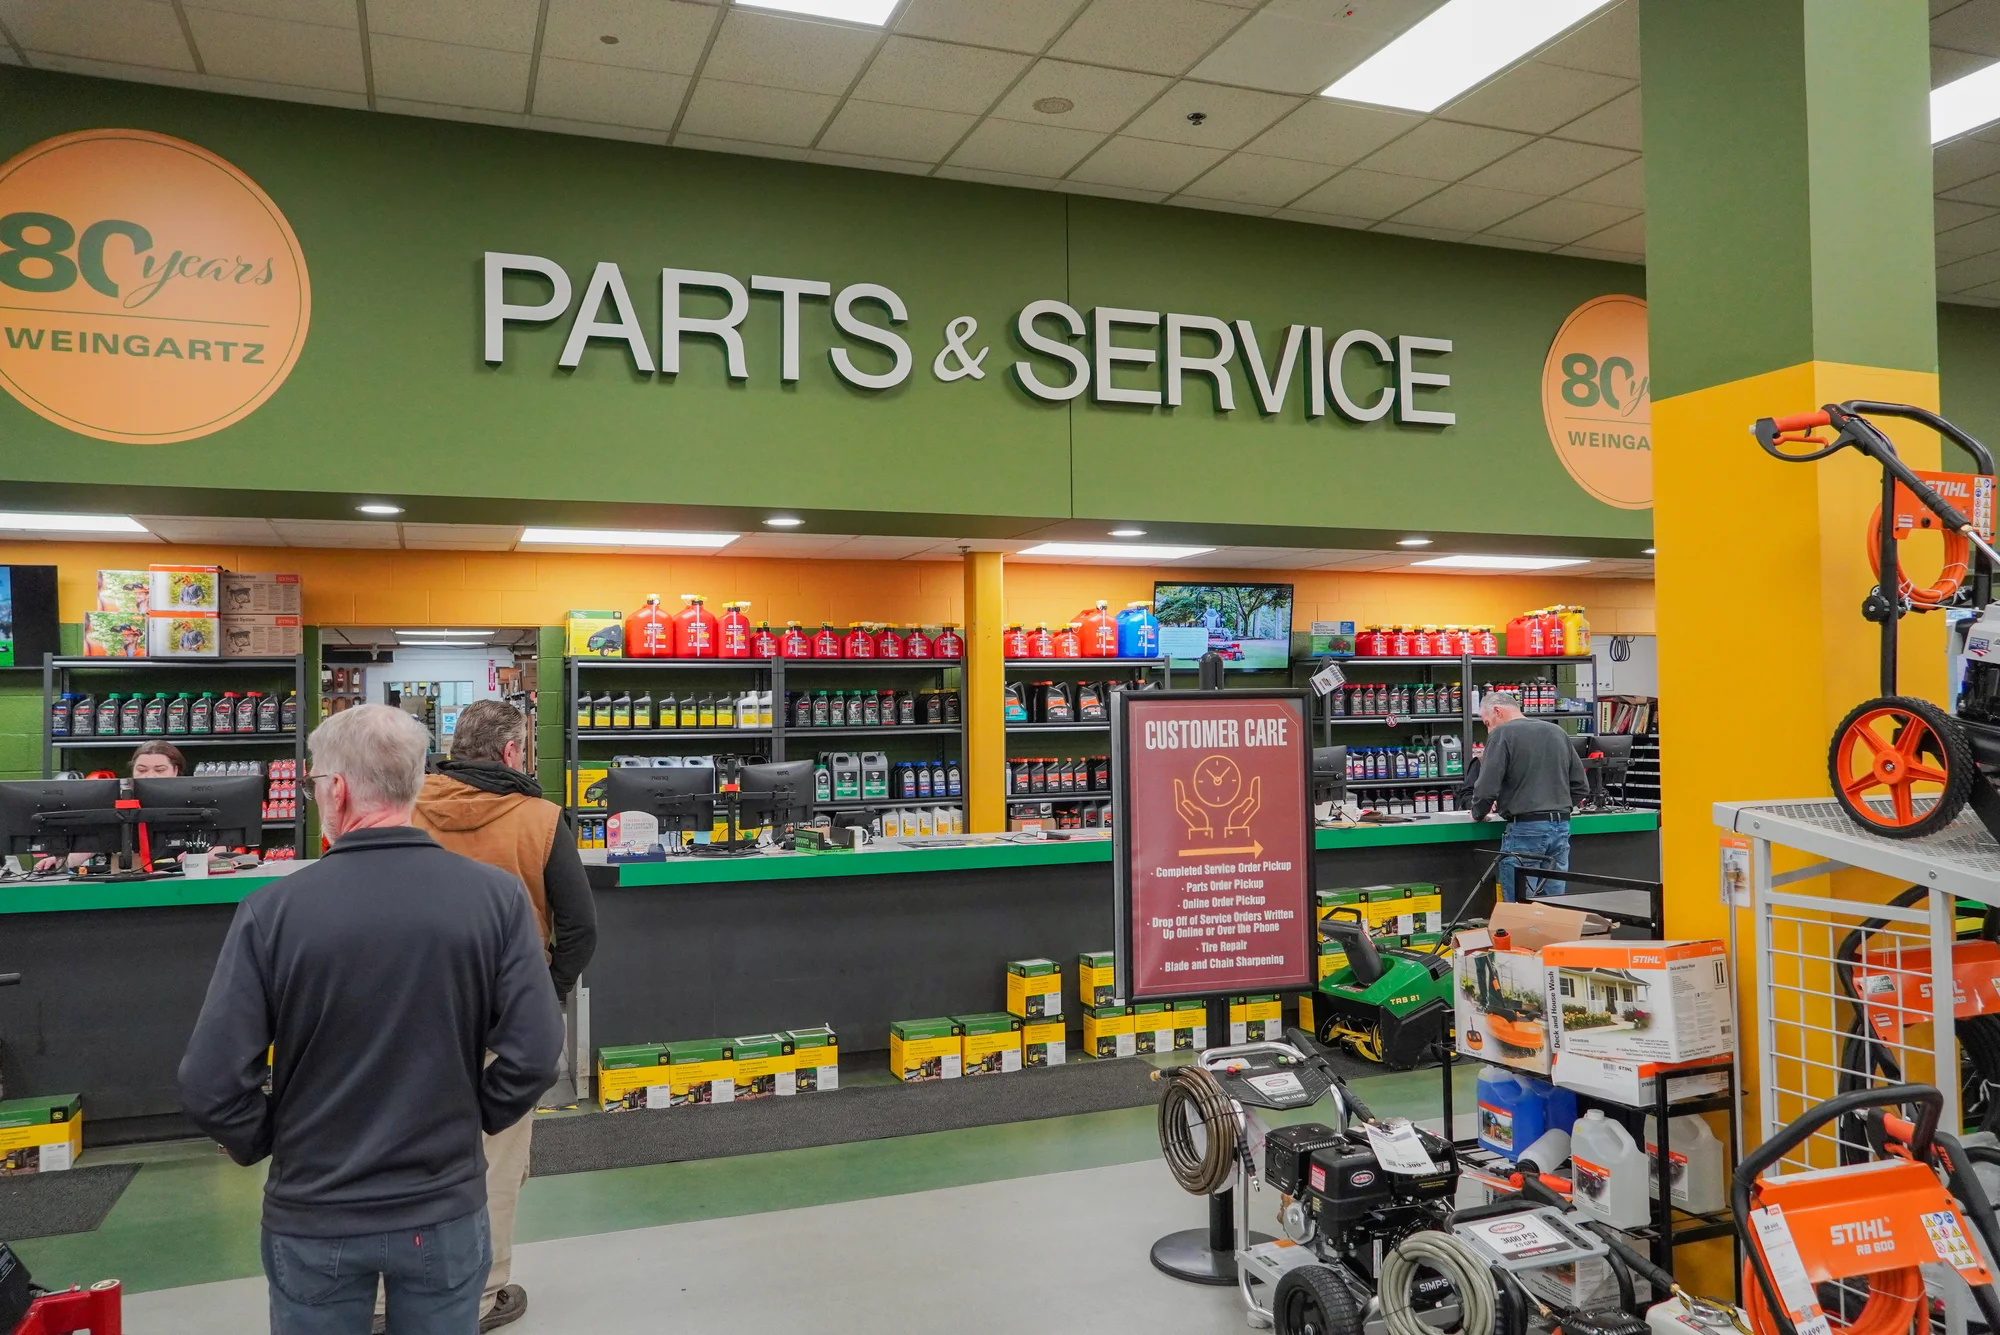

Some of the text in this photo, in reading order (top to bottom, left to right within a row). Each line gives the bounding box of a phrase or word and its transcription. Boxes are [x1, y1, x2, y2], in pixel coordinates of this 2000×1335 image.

[0, 211, 273, 308] 80 years
[4, 327, 266, 364] WEINGARTZ
[484, 251, 1456, 425] PARTS & SERVICE
[1561, 352, 1635, 410] 80
[1568, 430, 1650, 451] WEINGA
[1145, 718, 1288, 750] CUSTOMER CARE
[1156, 861, 1292, 878] Completed Service Order Pickup
[1186, 879, 1264, 892] Parts Order Pickup
[1182, 895, 1266, 910] Online Order Pickup
[1152, 910, 1294, 929] Drop Off of Service Orders Written
[1163, 922, 1280, 940] Up Online or Over the Phone
[1201, 940, 1248, 952] Tire Repair
[1164, 955, 1284, 972] Blade and Chain Sharpening
[1632, 955, 1662, 964] STIHL
[1548, 971, 1556, 992] Wash
[1550, 992, 1558, 1014] House
[1492, 1223, 1522, 1233] SIMPSON
[1830, 1220, 1892, 1246] STIHL
[1500, 1232, 1538, 1244] 3600 PSI
[1856, 1244, 1872, 1256] RB
[1420, 1278, 1449, 1292] SIMPS
